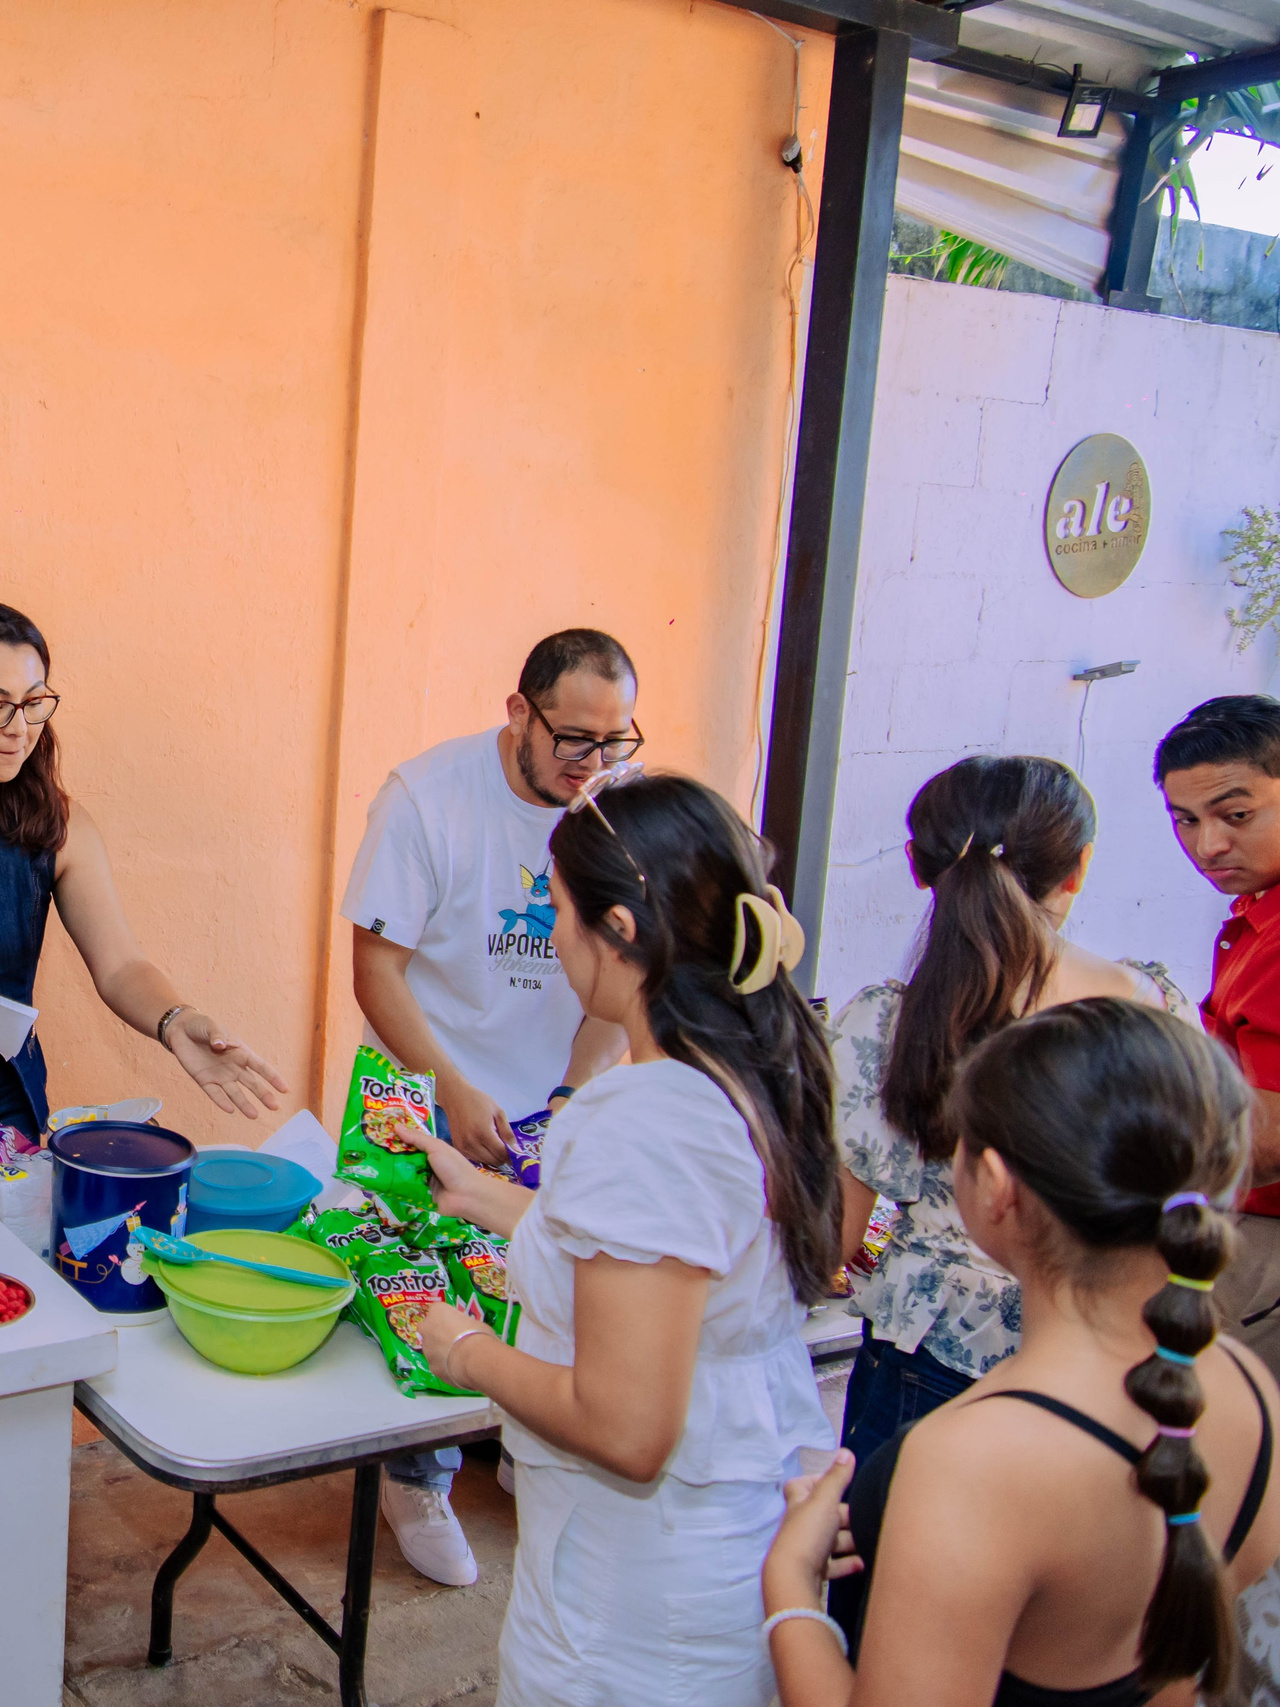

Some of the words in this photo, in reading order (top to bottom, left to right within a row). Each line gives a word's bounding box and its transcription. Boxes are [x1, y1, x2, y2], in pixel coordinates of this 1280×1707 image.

[1055, 480, 1133, 539] ale
[1055, 539, 1097, 556] cocina
[1110, 533, 1142, 548] amor
[488, 933, 560, 960] VAPORE
[522, 978, 542, 991] 0134
